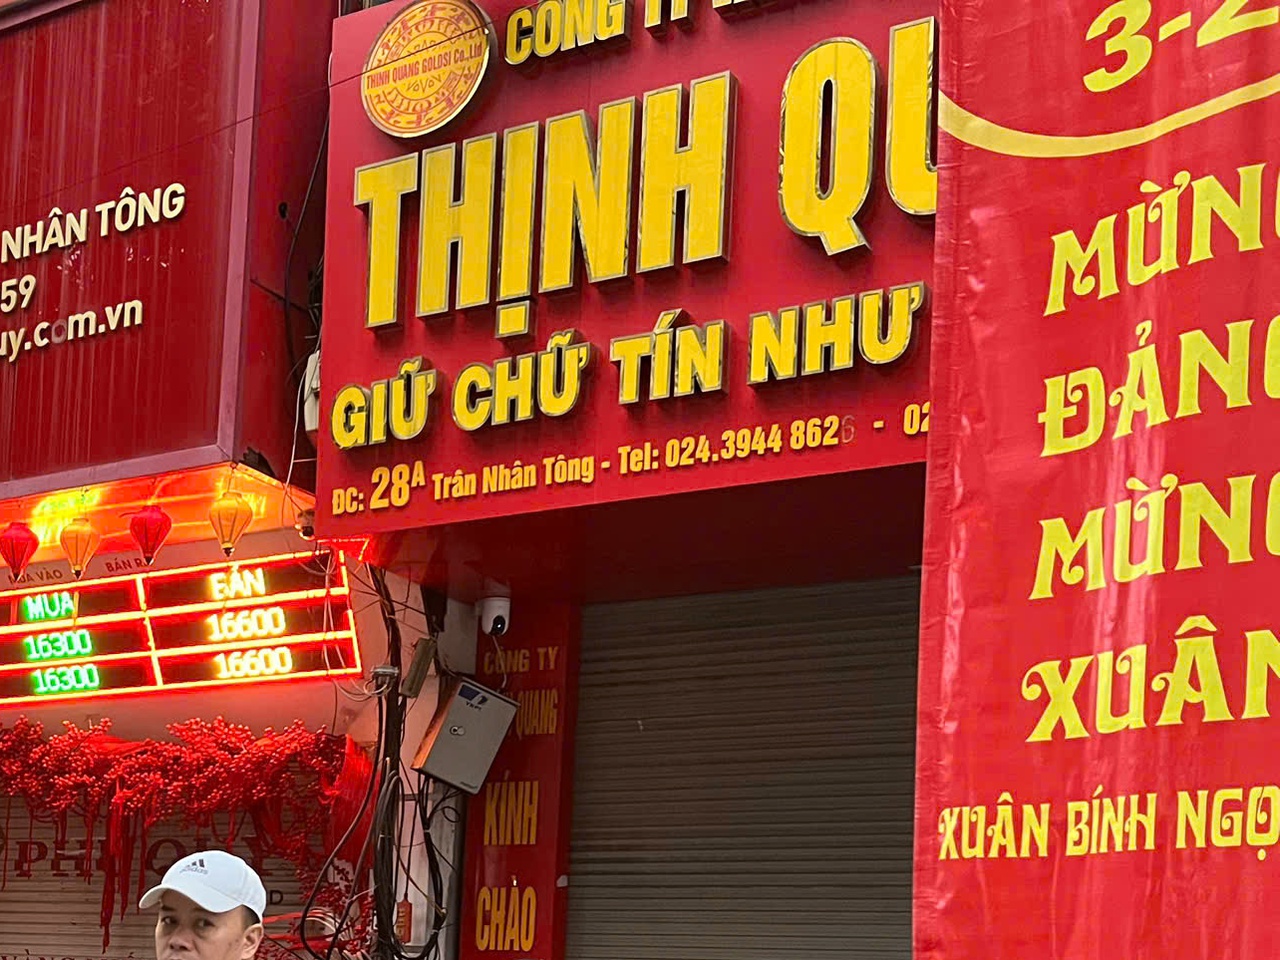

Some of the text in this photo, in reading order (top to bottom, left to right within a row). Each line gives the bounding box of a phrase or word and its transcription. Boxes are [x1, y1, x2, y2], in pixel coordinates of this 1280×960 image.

[1, 206, 88, 264] NHÂN
[95, 182, 186, 238] TÔNG
[354, 70, 734, 338] THỊNH
[1042, 162, 1280, 317] MỪN
[331, 281, 926, 451] GIỮ CHỮ TÍN NHƯ
[1037, 319, 1280, 458] ĐẢN
[332, 488, 365, 516] ĐC:
[482, 460, 537, 495] Nhân
[543, 454, 595, 485] Tông
[618, 441, 659, 475] Tel:
[665, 422, 783, 468] 024.3944
[105, 557, 133, 573] BÁN
[1028, 472, 1280, 600] MỪN
[23, 590, 75, 620] MUA
[209, 563, 267, 601] BÁN
[23, 629, 93, 661] 16300
[206, 605, 287, 642] 16600
[483, 646, 559, 675] CÔNG TY
[31, 663, 101, 694] 16300
[214, 646, 293, 680] 16600
[483, 769, 540, 847] KÍNH
[938, 784, 1280, 861] XUÂN BÍNH NGỌ
